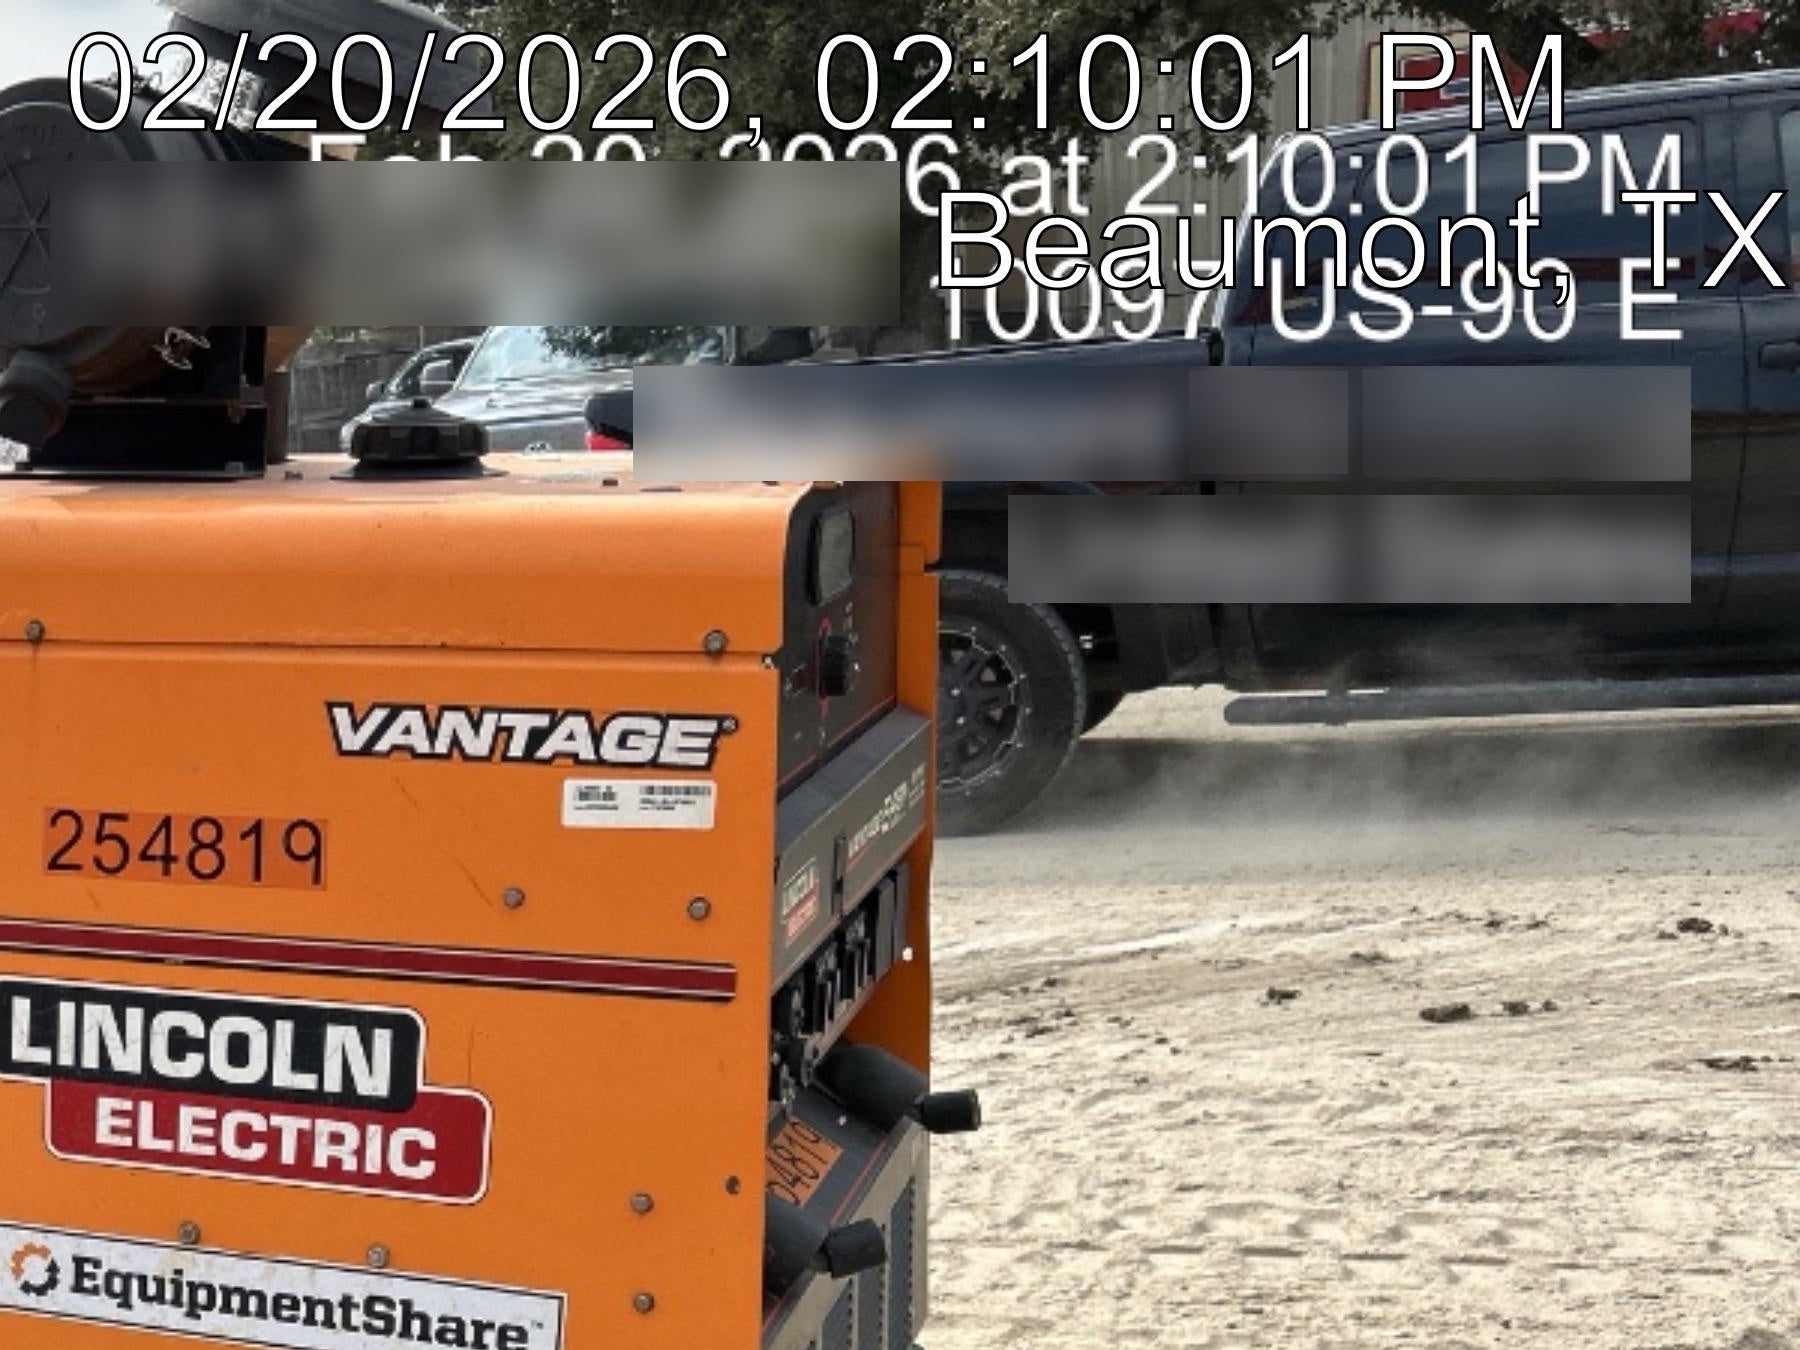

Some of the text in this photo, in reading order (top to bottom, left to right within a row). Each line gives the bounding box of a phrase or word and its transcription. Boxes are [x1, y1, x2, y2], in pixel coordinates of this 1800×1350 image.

[327, 702, 722, 770] VANTAGE
[46, 808, 323, 885] 254819
[10, 995, 393, 1098] LINCOLN
[95, 1097, 436, 1180] ELECTRIC
